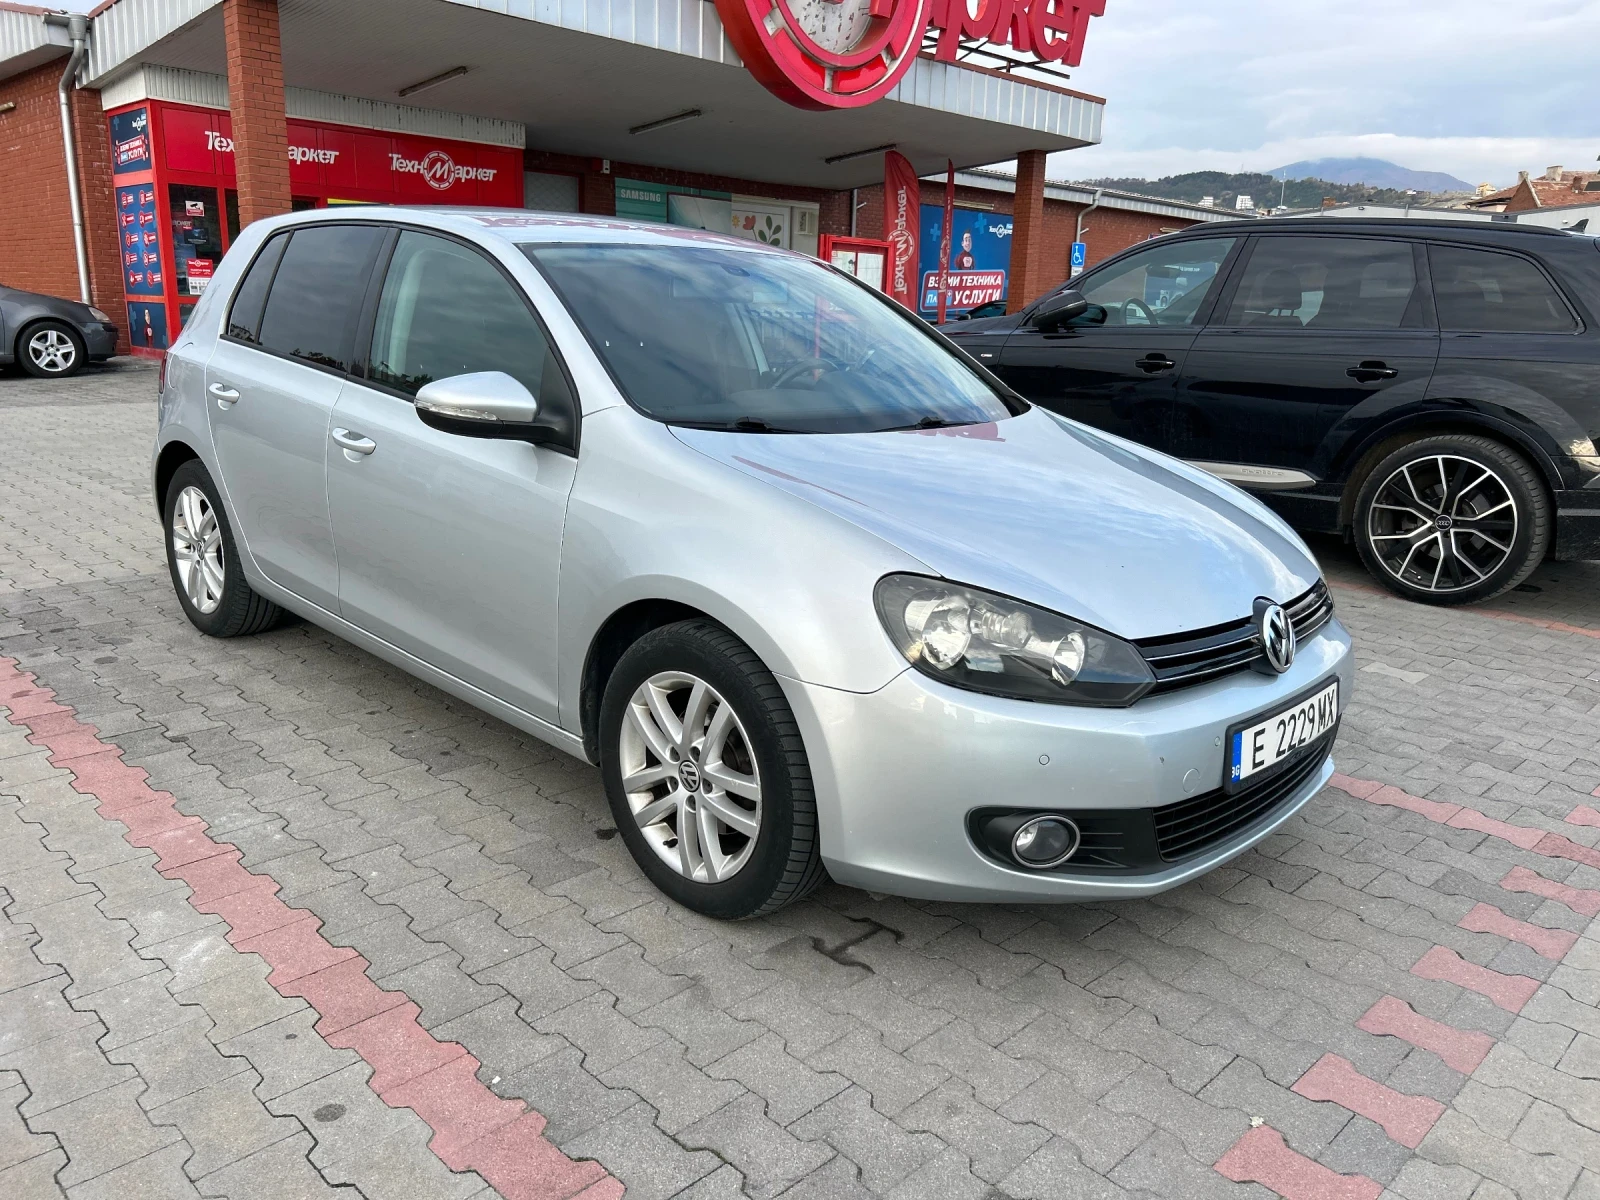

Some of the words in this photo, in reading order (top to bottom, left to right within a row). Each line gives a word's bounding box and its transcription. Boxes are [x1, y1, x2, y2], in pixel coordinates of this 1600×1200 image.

[620, 189, 661, 202] SAMSUNG
[962, 275, 1001, 286] ТЕХНИКА
[954, 288, 1000, 305] УСЛУГИ
[1252, 727, 1266, 770] E
[1275, 702, 1316, 759] 2229
[1317, 688, 1335, 735] MX
